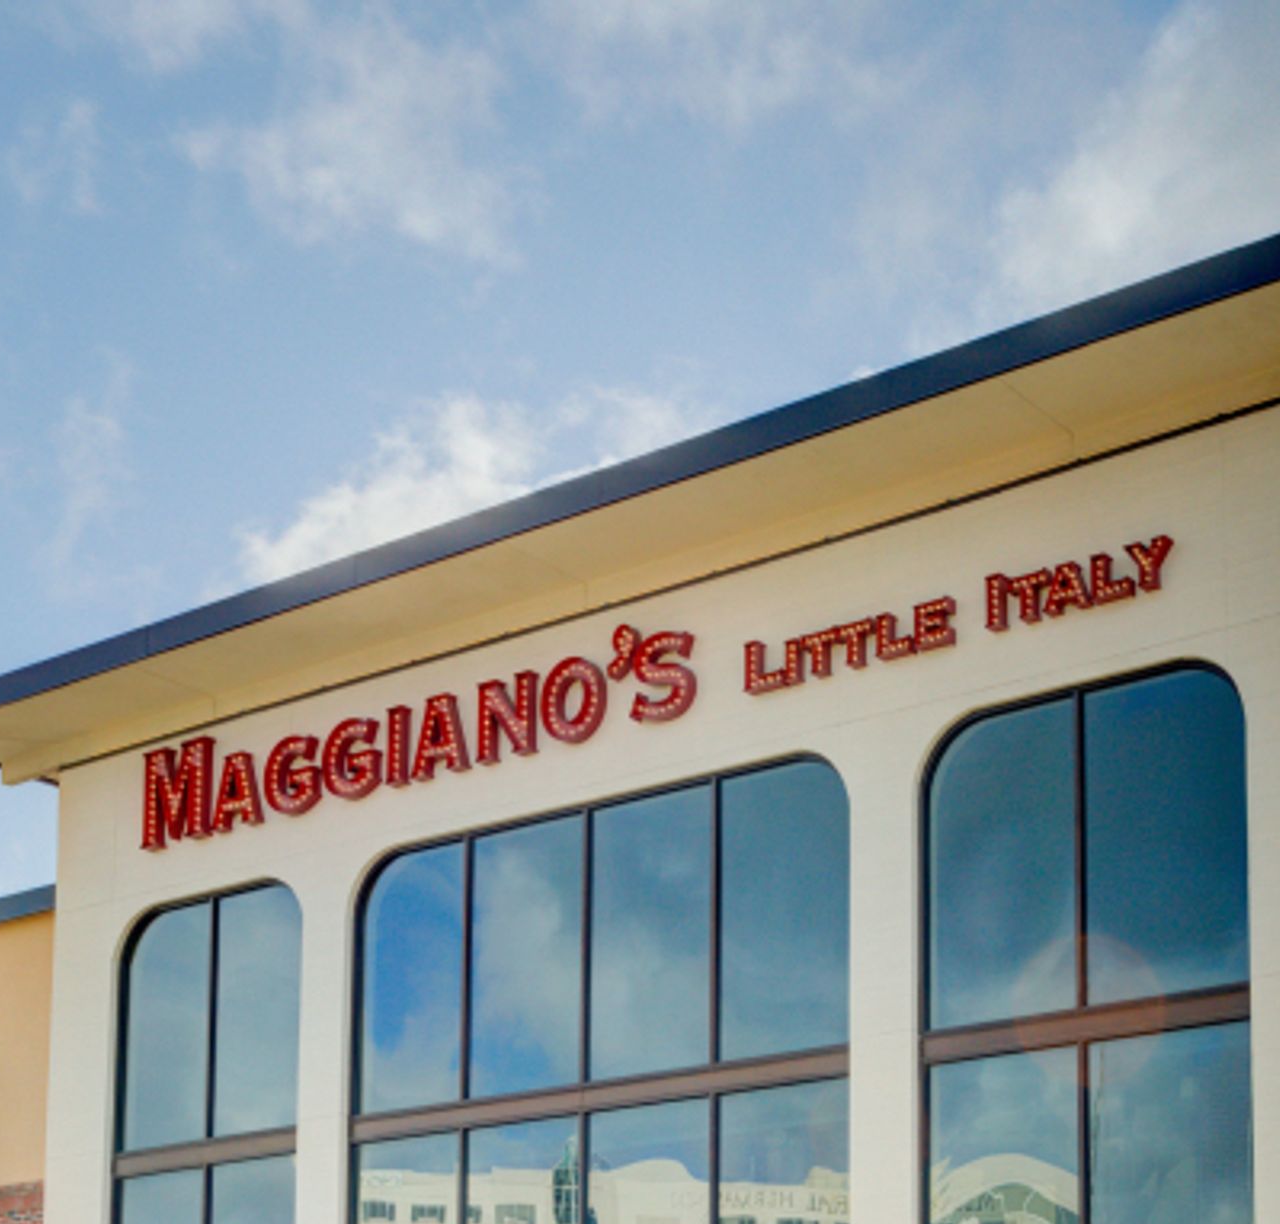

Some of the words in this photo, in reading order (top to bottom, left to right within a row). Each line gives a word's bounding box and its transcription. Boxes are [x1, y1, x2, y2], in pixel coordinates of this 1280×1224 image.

[743, 595, 957, 696] LITTLE
[984, 534, 1174, 633] ITALY
[140, 623, 698, 851] MAGGIANO'S
